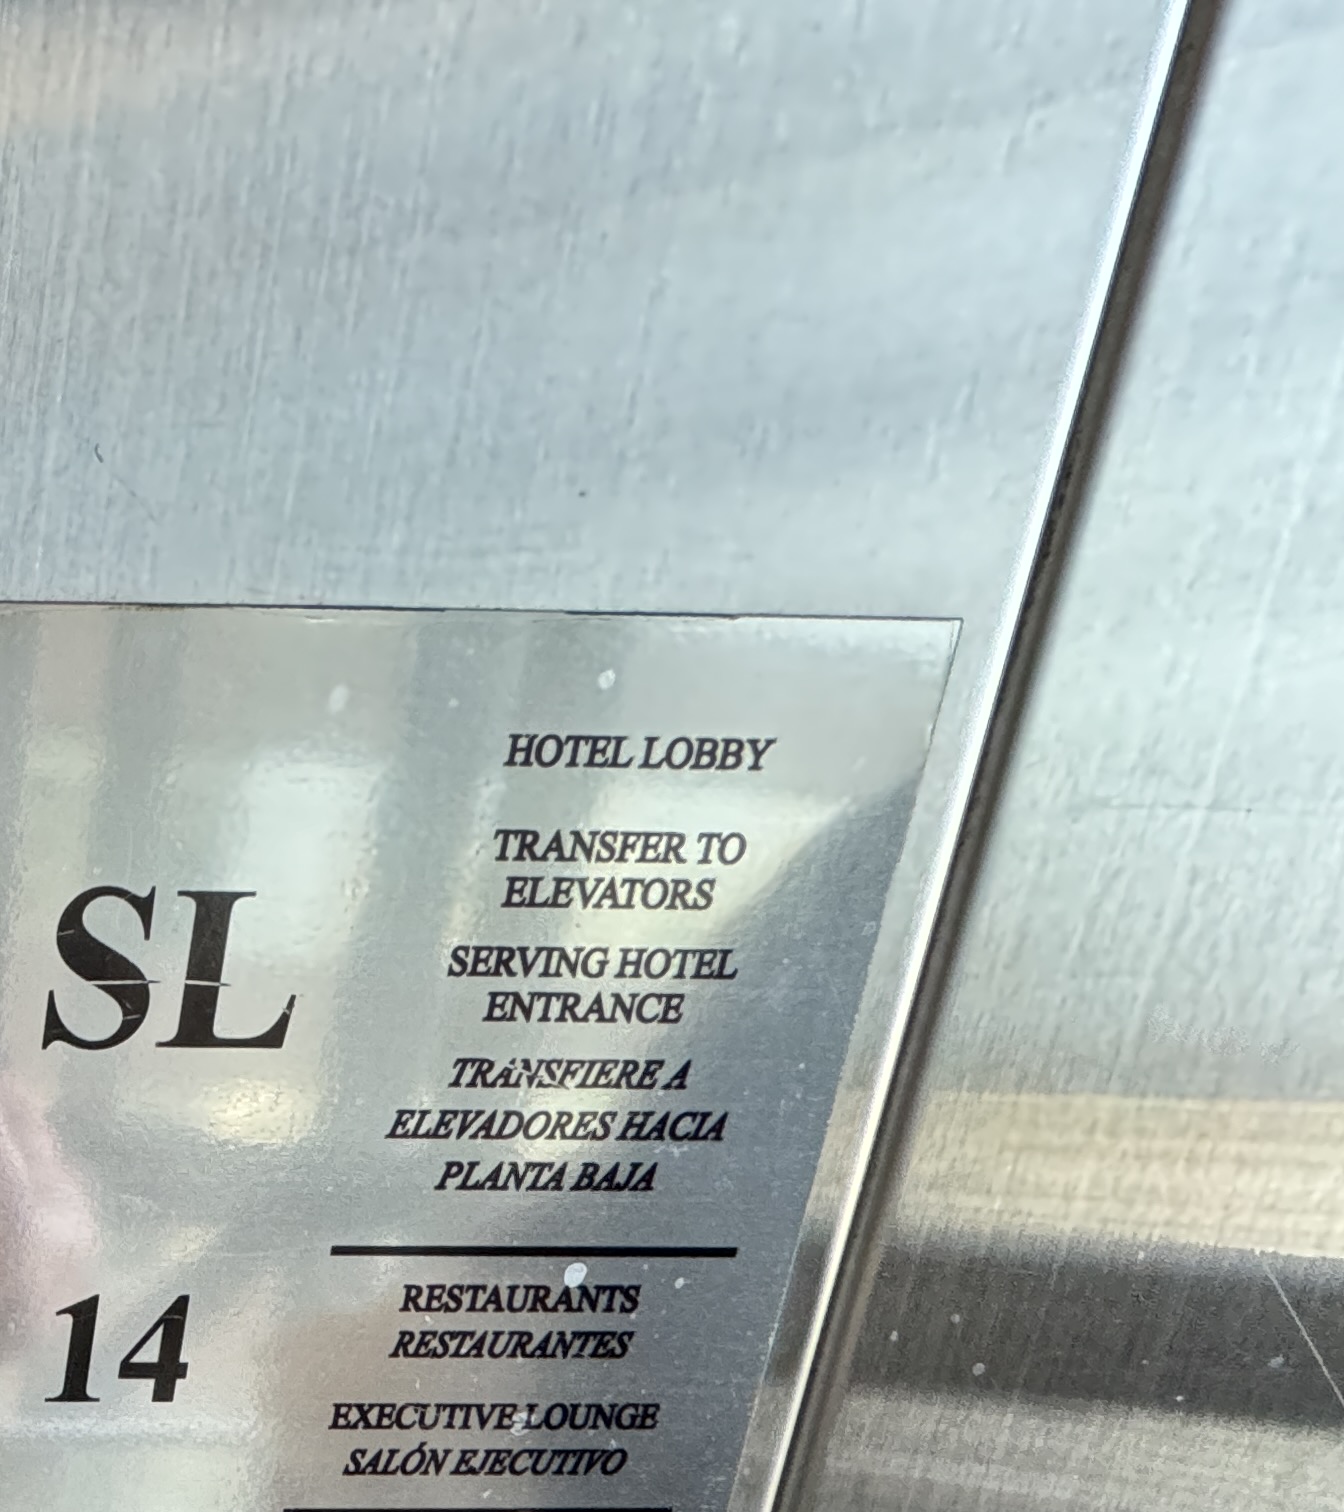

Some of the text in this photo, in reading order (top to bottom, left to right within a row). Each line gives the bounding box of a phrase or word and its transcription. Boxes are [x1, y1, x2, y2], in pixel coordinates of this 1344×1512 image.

[504, 733, 776, 772] HOTEL LOBBY
[493, 829, 747, 865] TRANSFER TO
[501, 877, 716, 912] ELEVATORS
[41, 884, 298, 1052] SL
[447, 946, 739, 981] SERVING HOTEL
[482, 993, 685, 1027] ENTRANCE
[448, 1058, 693, 1089] TRANSFIERE A
[384, 1110, 730, 1142] ELEVADORES HACIA
[434, 1161, 660, 1192] PLANTA BAJA
[401, 1285, 642, 1315] RESTAURANTS
[44, 1294, 192, 1403] 14
[389, 1331, 634, 1360] RESTAURANTES
[329, 1403, 661, 1431] EXECUTIVE LOUNGE
[342, 1442, 628, 1478] SALÓN EJECUTIVO
